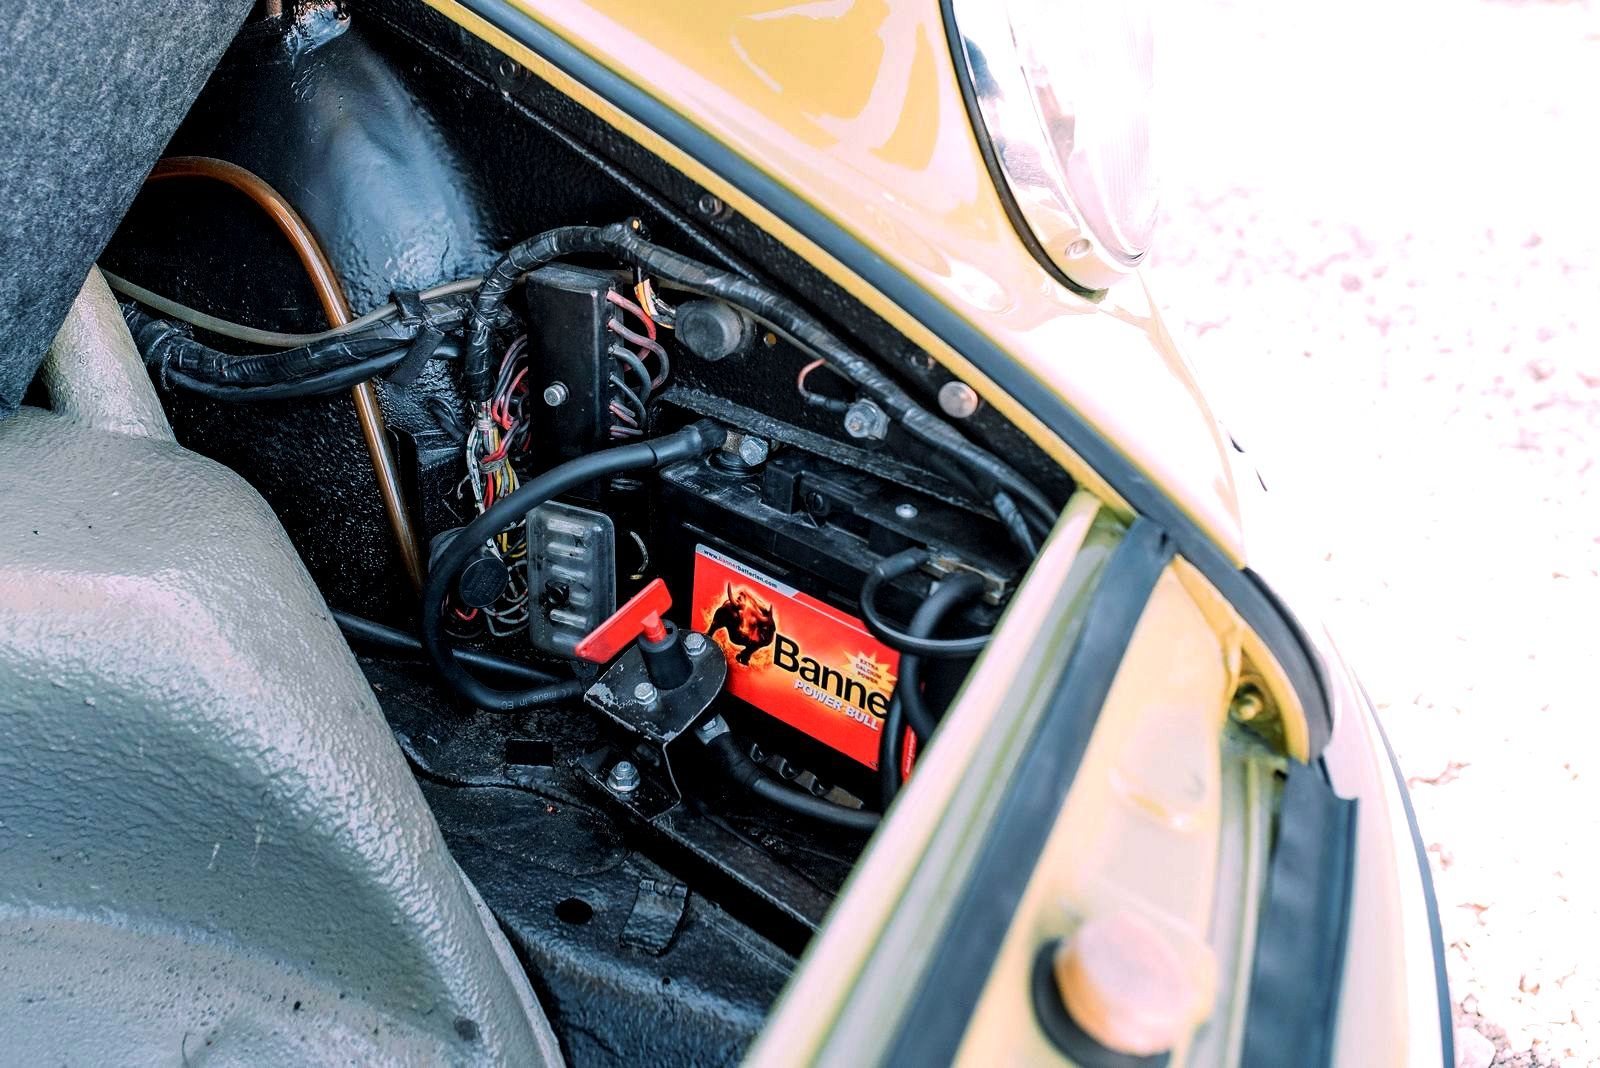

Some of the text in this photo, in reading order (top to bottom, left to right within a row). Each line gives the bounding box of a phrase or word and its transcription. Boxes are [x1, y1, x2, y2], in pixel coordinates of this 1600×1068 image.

[703, 550, 778, 588] www.bannerbatterien.com
[855, 663, 882, 679] CALCIUM
[860, 659, 879, 671] EXTRA
[857, 671, 879, 684] POWER
[532, 691, 557, 702] made
[794, 680, 880, 732] POWER BULL
